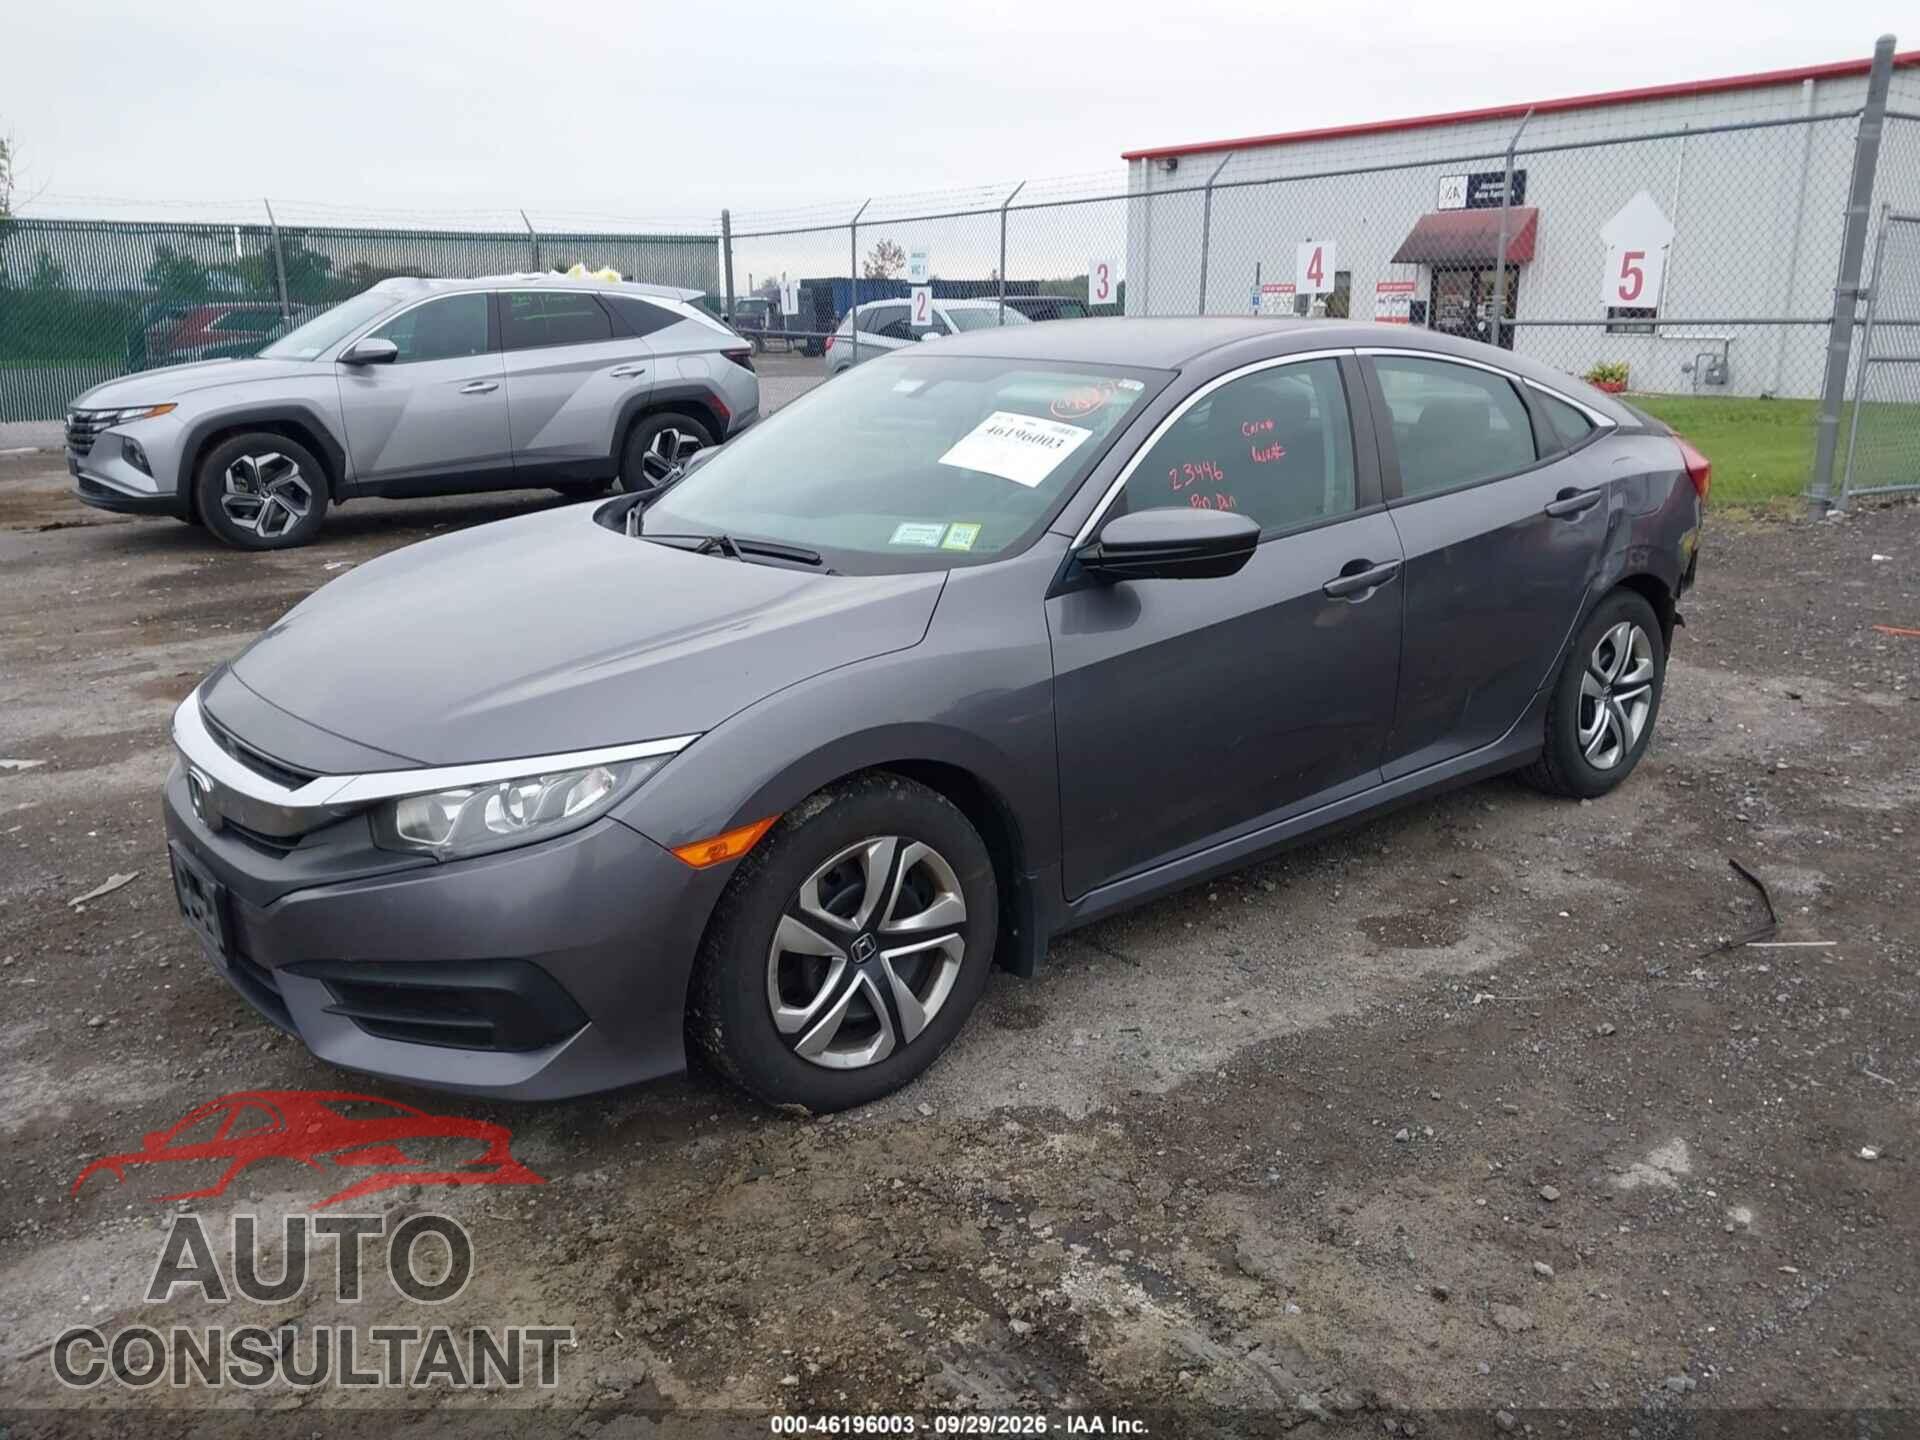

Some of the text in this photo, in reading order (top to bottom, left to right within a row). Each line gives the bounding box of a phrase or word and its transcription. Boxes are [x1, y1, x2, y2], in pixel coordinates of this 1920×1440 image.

[1097, 263, 1109, 300] 3
[1307, 246, 1323, 288] 4
[1619, 251, 1645, 300] 5
[785, 283, 791, 311] 1
[917, 292, 926, 321] 2
[984, 425, 1065, 449] 46196003
[1169, 461, 1223, 490] 23446
